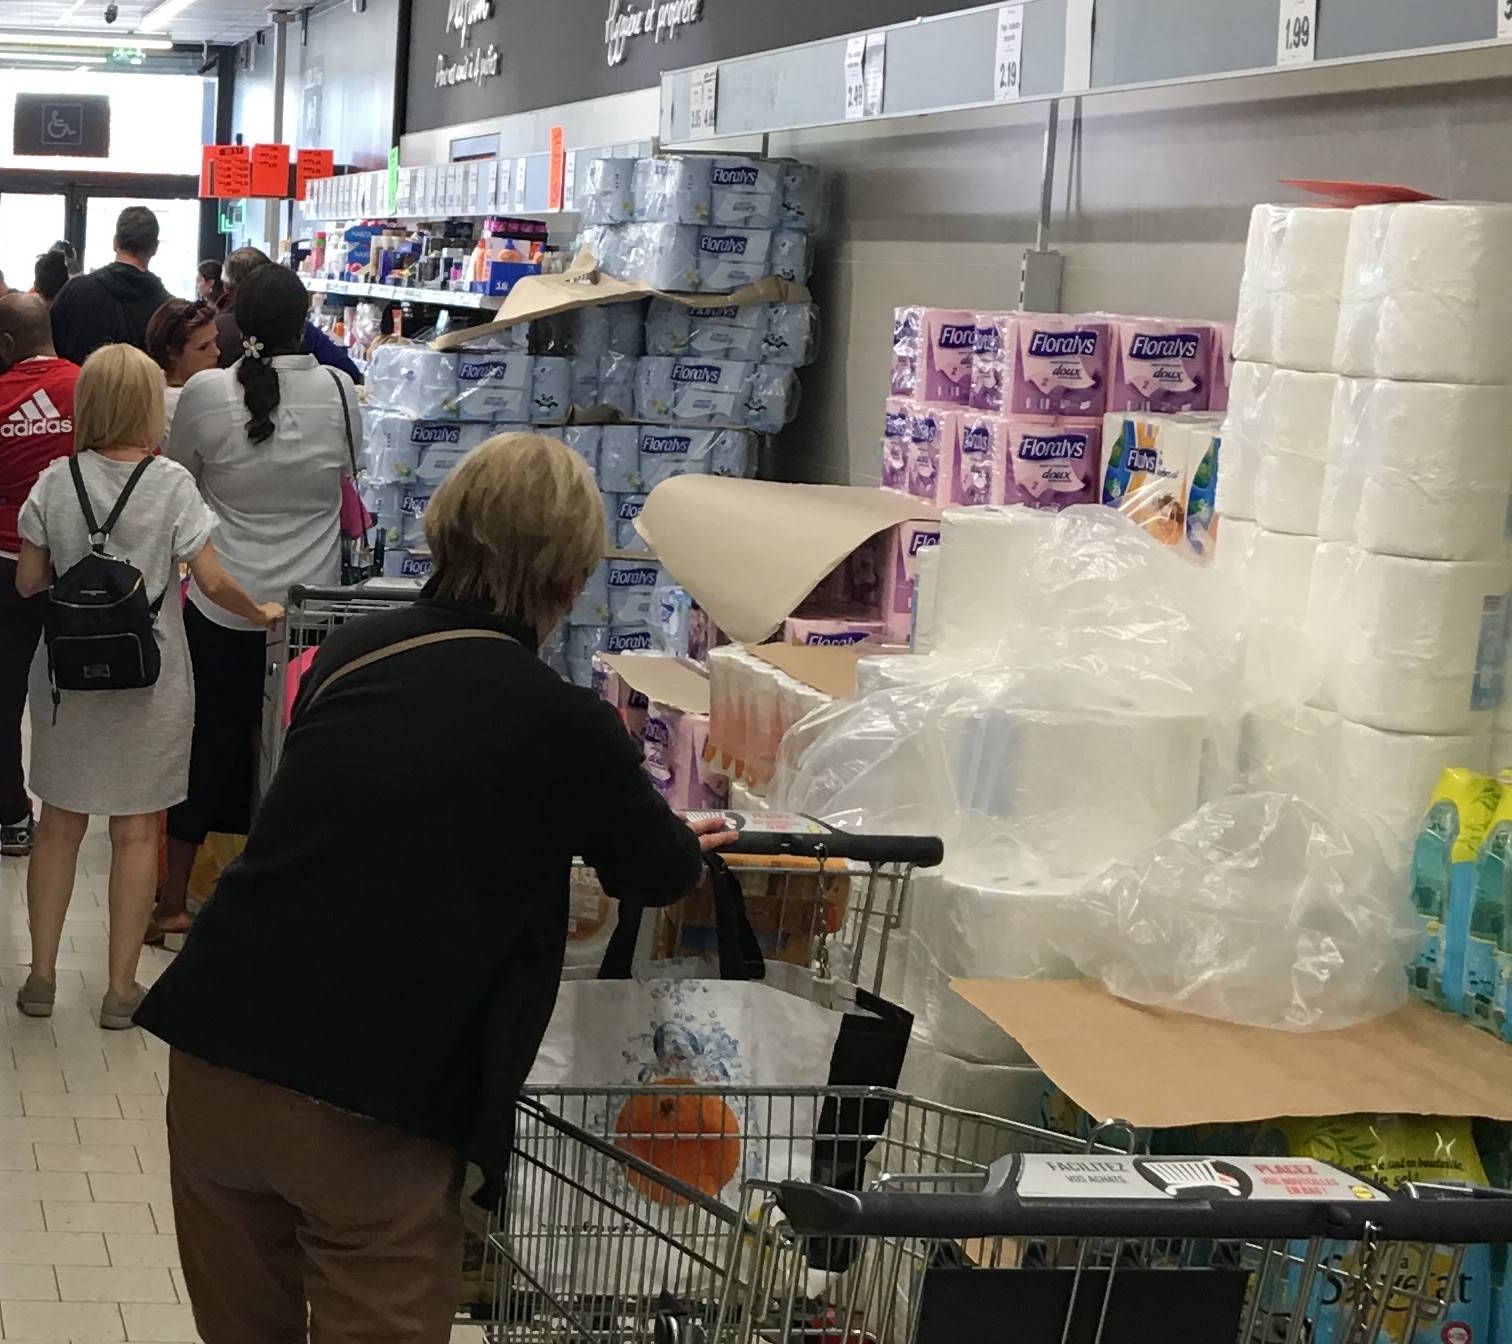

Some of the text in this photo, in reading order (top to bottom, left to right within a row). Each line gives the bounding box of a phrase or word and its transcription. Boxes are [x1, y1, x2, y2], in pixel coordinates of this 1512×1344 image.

[1285, 15, 1310, 51] 1.99
[999, 61, 1018, 88] 2.19
[713, 167, 757, 184] Floralys
[701, 236, 746, 253] Floralys
[1032, 332, 1096, 356] Floralys
[1131, 333, 1198, 357] Floralys
[671, 365, 721, 384] Floralys
[1052, 366, 1082, 379] doux
[1153, 367, 1183, 381] doux
[1041, 377, 1049, 387] 2
[1142, 379, 1149, 390] 2
[0, 417, 73, 437] adidas
[413, 425, 461, 444] Floralys
[642, 436, 690, 453] Floralys
[1021, 438, 1085, 458] Floralys
[1041, 468, 1072, 481] doux
[610, 569, 656, 586] Floralys
[1047, 1161, 1130, 1173] FACILITEZ
[1254, 1164, 1319, 1175] PLACEZ
